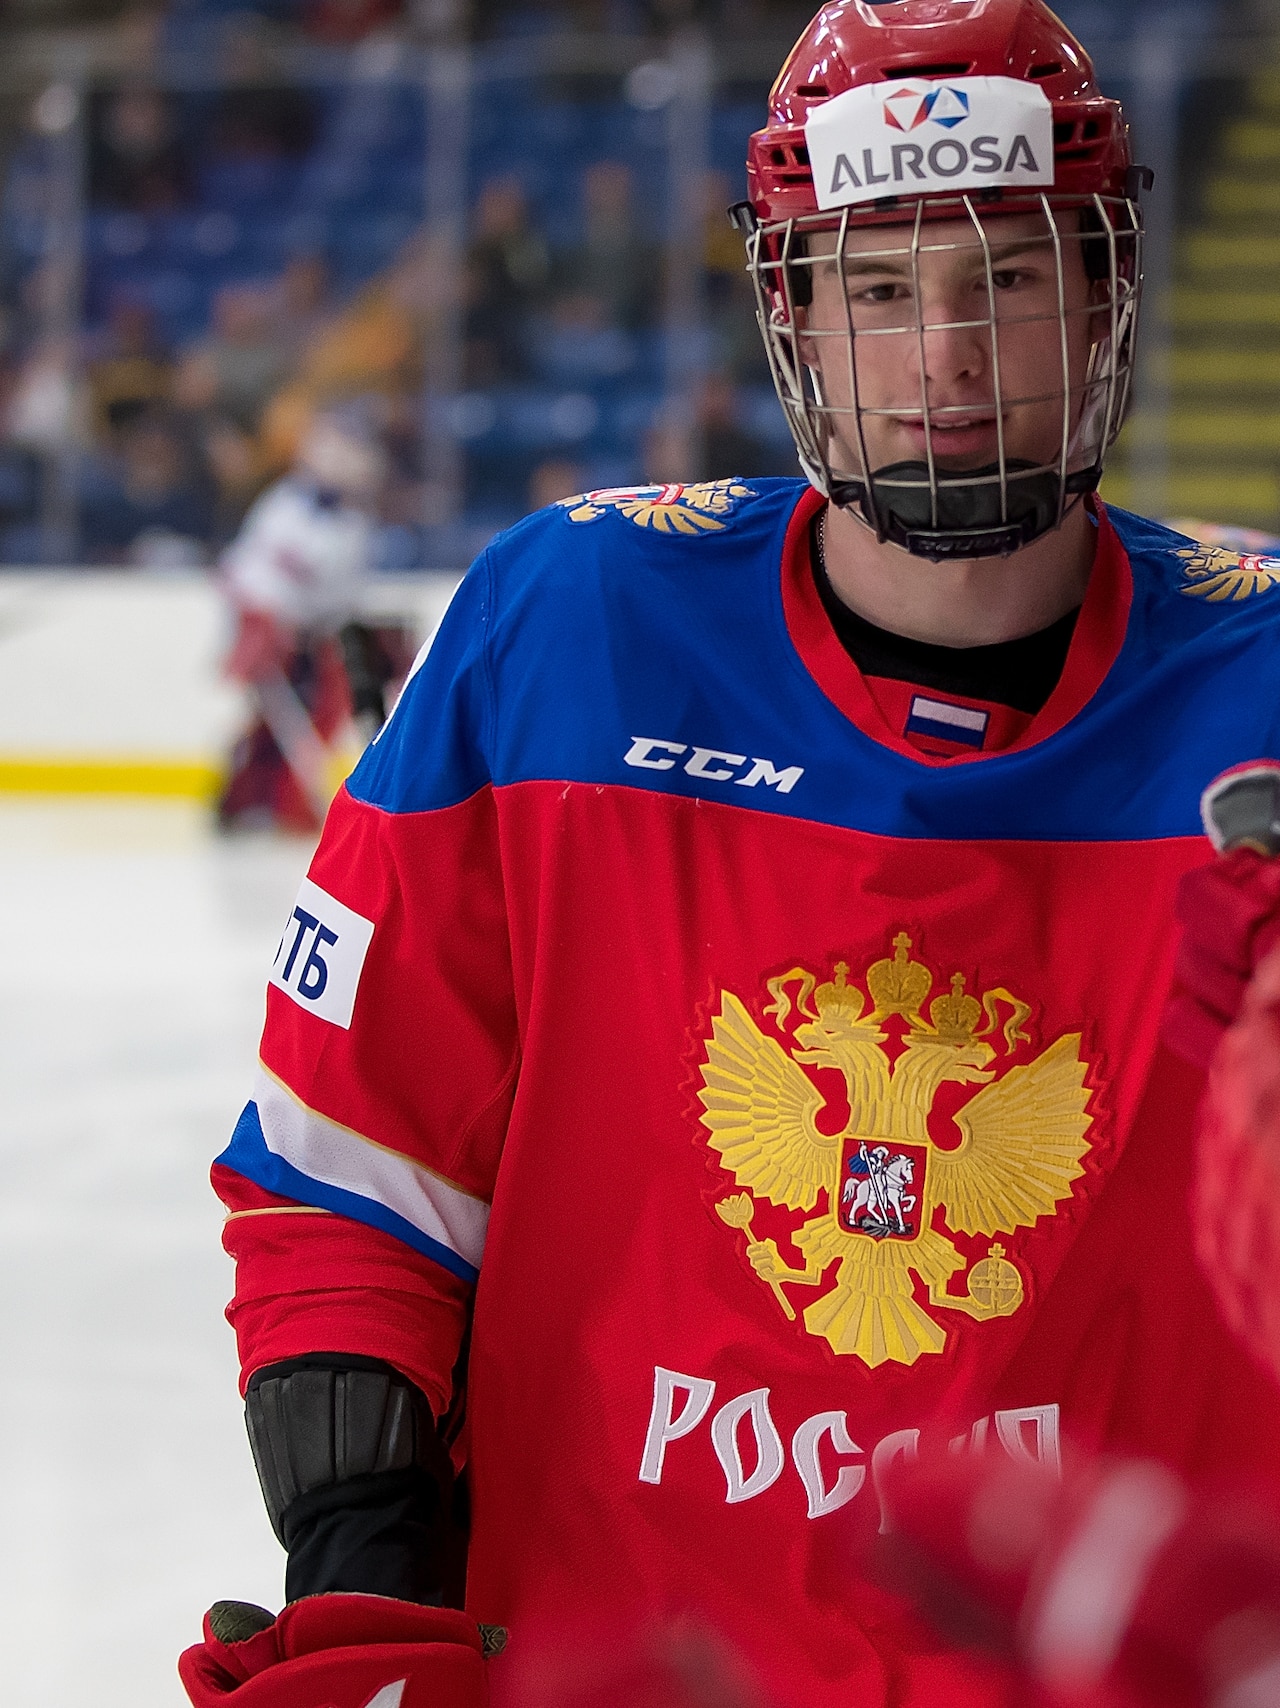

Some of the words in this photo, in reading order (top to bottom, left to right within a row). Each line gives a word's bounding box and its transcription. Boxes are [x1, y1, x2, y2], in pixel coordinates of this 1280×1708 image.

[830, 135, 1039, 193] ALROSA
[623, 736, 804, 793] CCM
[273, 905, 340, 1000] ТБ
